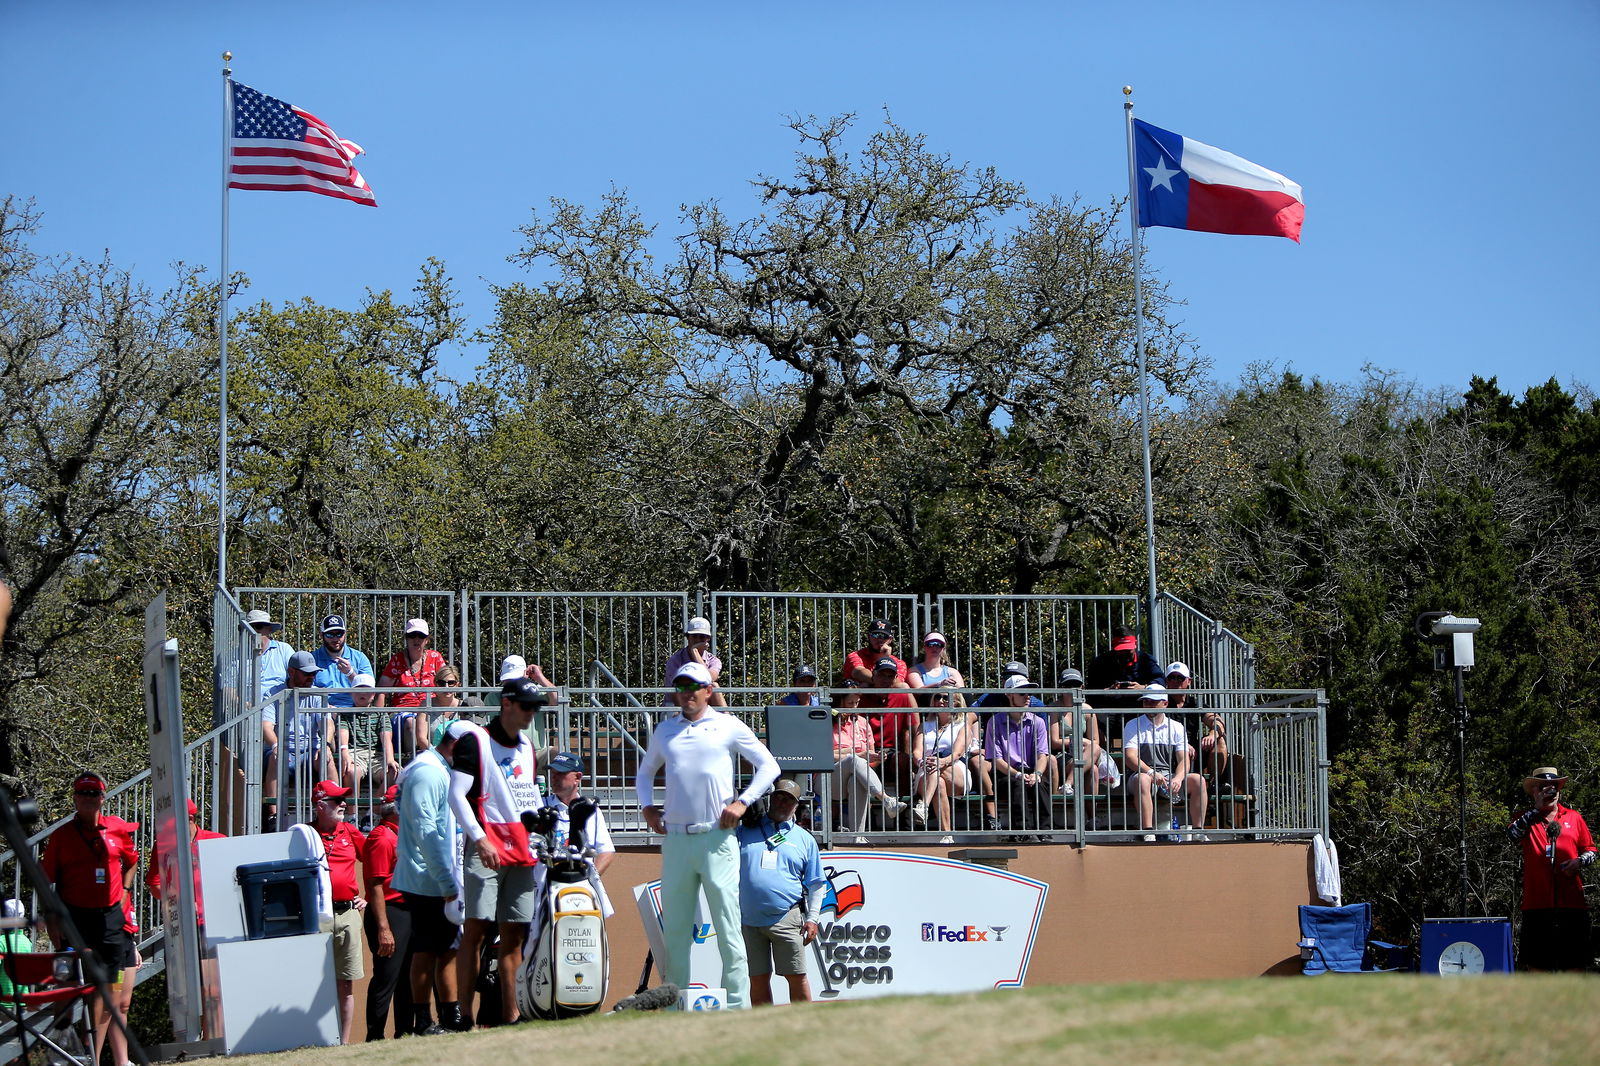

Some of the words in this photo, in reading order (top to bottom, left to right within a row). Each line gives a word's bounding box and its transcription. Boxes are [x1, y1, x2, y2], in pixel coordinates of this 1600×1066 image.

[150, 672, 162, 735] 1
[512, 789, 535, 798] Texas
[517, 798, 537, 808] Open
[568, 928, 592, 937] DYLAN
[816, 921, 892, 943] Valero
[937, 925, 989, 942] FedEx
[562, 939, 597, 948] FRITTELLI
[820, 942, 892, 963] Texas
[827, 962, 894, 988] Open
